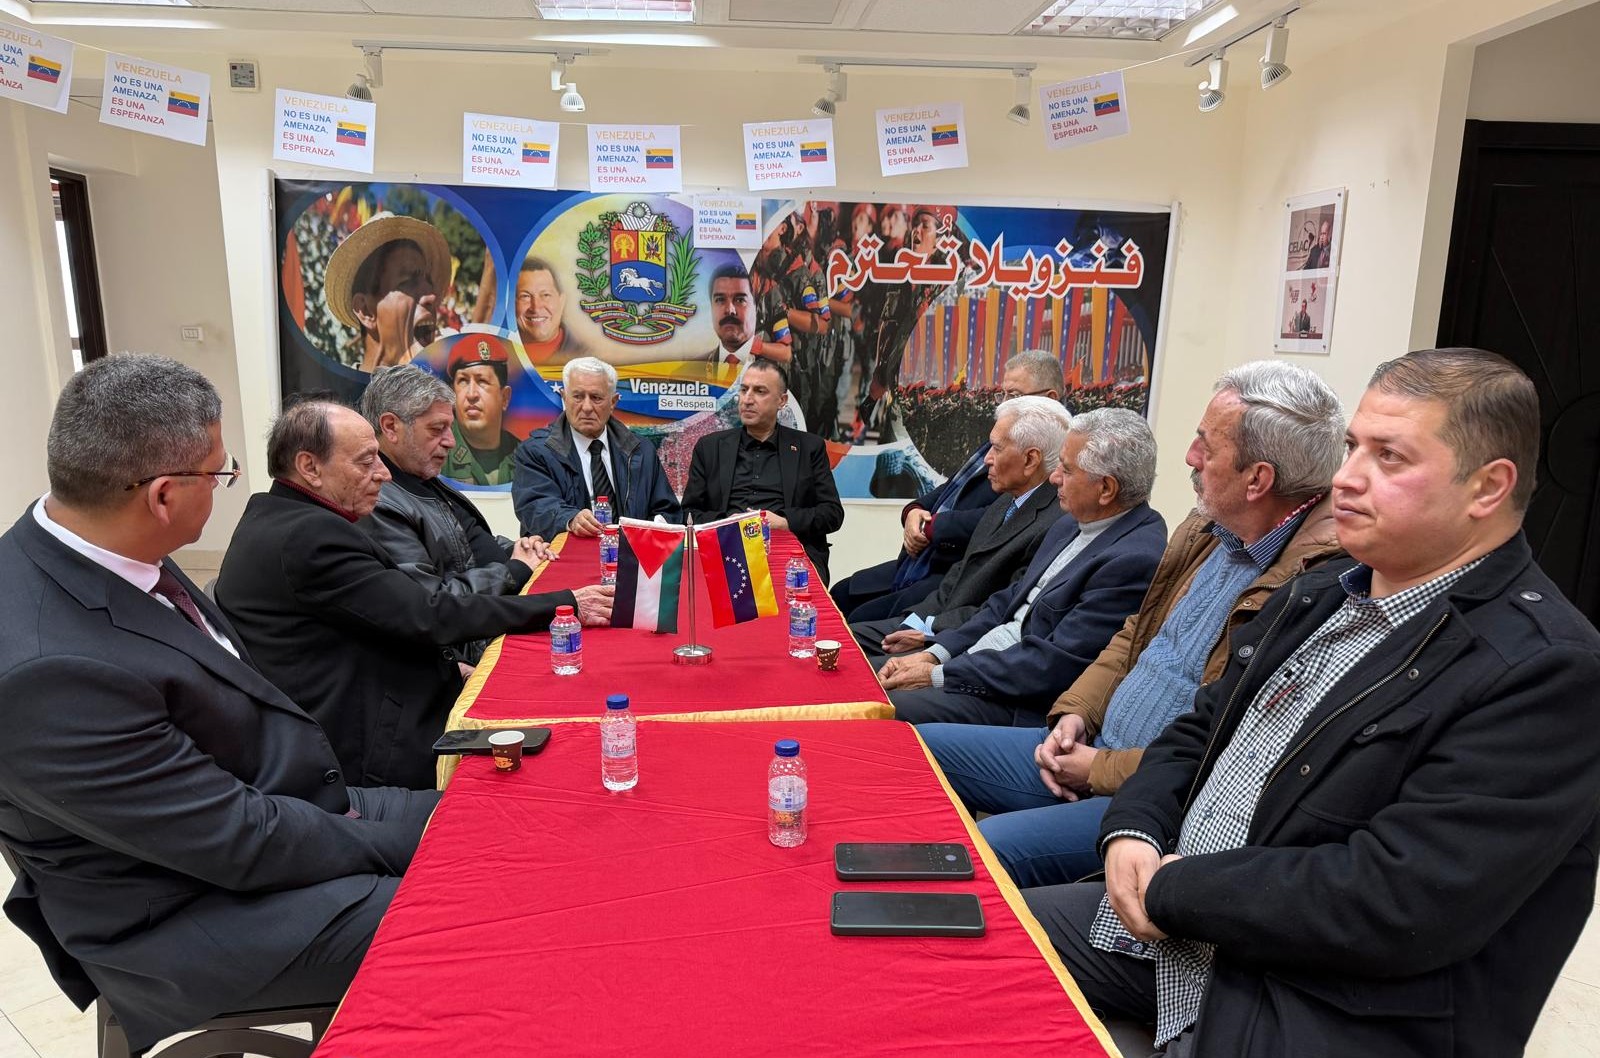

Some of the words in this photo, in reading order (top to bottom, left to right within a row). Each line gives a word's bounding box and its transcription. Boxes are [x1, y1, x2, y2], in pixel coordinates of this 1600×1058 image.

[3, 43, 23, 56] UNA
[115, 61, 182, 83] VENEZUELA
[113, 74, 127, 84] NO
[129, 79, 142, 87] ES
[144, 81, 164, 92] UNA
[1047, 81, 1101, 98] VENEZUELA
[112, 97, 124, 106] ES
[126, 100, 146, 111] UNA
[284, 96, 348, 113] VENEZUELA
[1048, 102, 1060, 111] NO
[1061, 100, 1071, 108] ES
[1073, 96, 1089, 105] UNA
[110, 107, 165, 126] ESPERANZA
[283, 109, 297, 118] NO
[299, 112, 310, 120] ES
[313, 114, 332, 123] UNA
[884, 110, 940, 123] VENEZUELA
[472, 120, 533, 134] VENEZUELA
[885, 127, 896, 135] NO
[898, 126, 908, 134] ES
[910, 124, 926, 133] UNA
[1063, 119, 1079, 128] UNA
[283, 131, 294, 140] ES
[297, 134, 316, 143] UNA
[595, 130, 656, 140] VENEZUELA
[751, 125, 808, 137] VENEZUELA
[1054, 125, 1098, 140] ESPERANZA
[472, 133, 484, 142] NO
[486, 135, 497, 143] ES
[499, 136, 517, 145] UNA
[753, 142, 764, 150] NO
[766, 141, 776, 149] ES
[778, 140, 795, 148] UNA
[282, 142, 335, 157] ESPERANZA
[887, 148, 897, 156] ES
[899, 147, 916, 155] UNA
[471, 155, 483, 163] ES
[485, 157, 503, 165] UNA
[755, 163, 765, 171] ES
[767, 162, 783, 170] UNA
[888, 154, 935, 166] ESPERANZA
[471, 166, 521, 176] ESPERANZA
[610, 166, 627, 174] UNA
[755, 171, 802, 180] ESPERANZA
[1288, 239, 1309, 254] CELAC
[969, 231, 1145, 301] فنزويلا
[629, 378, 709, 396] Venezuela
[660, 398, 673, 407] Se
[676, 399, 714, 409] Respeta
